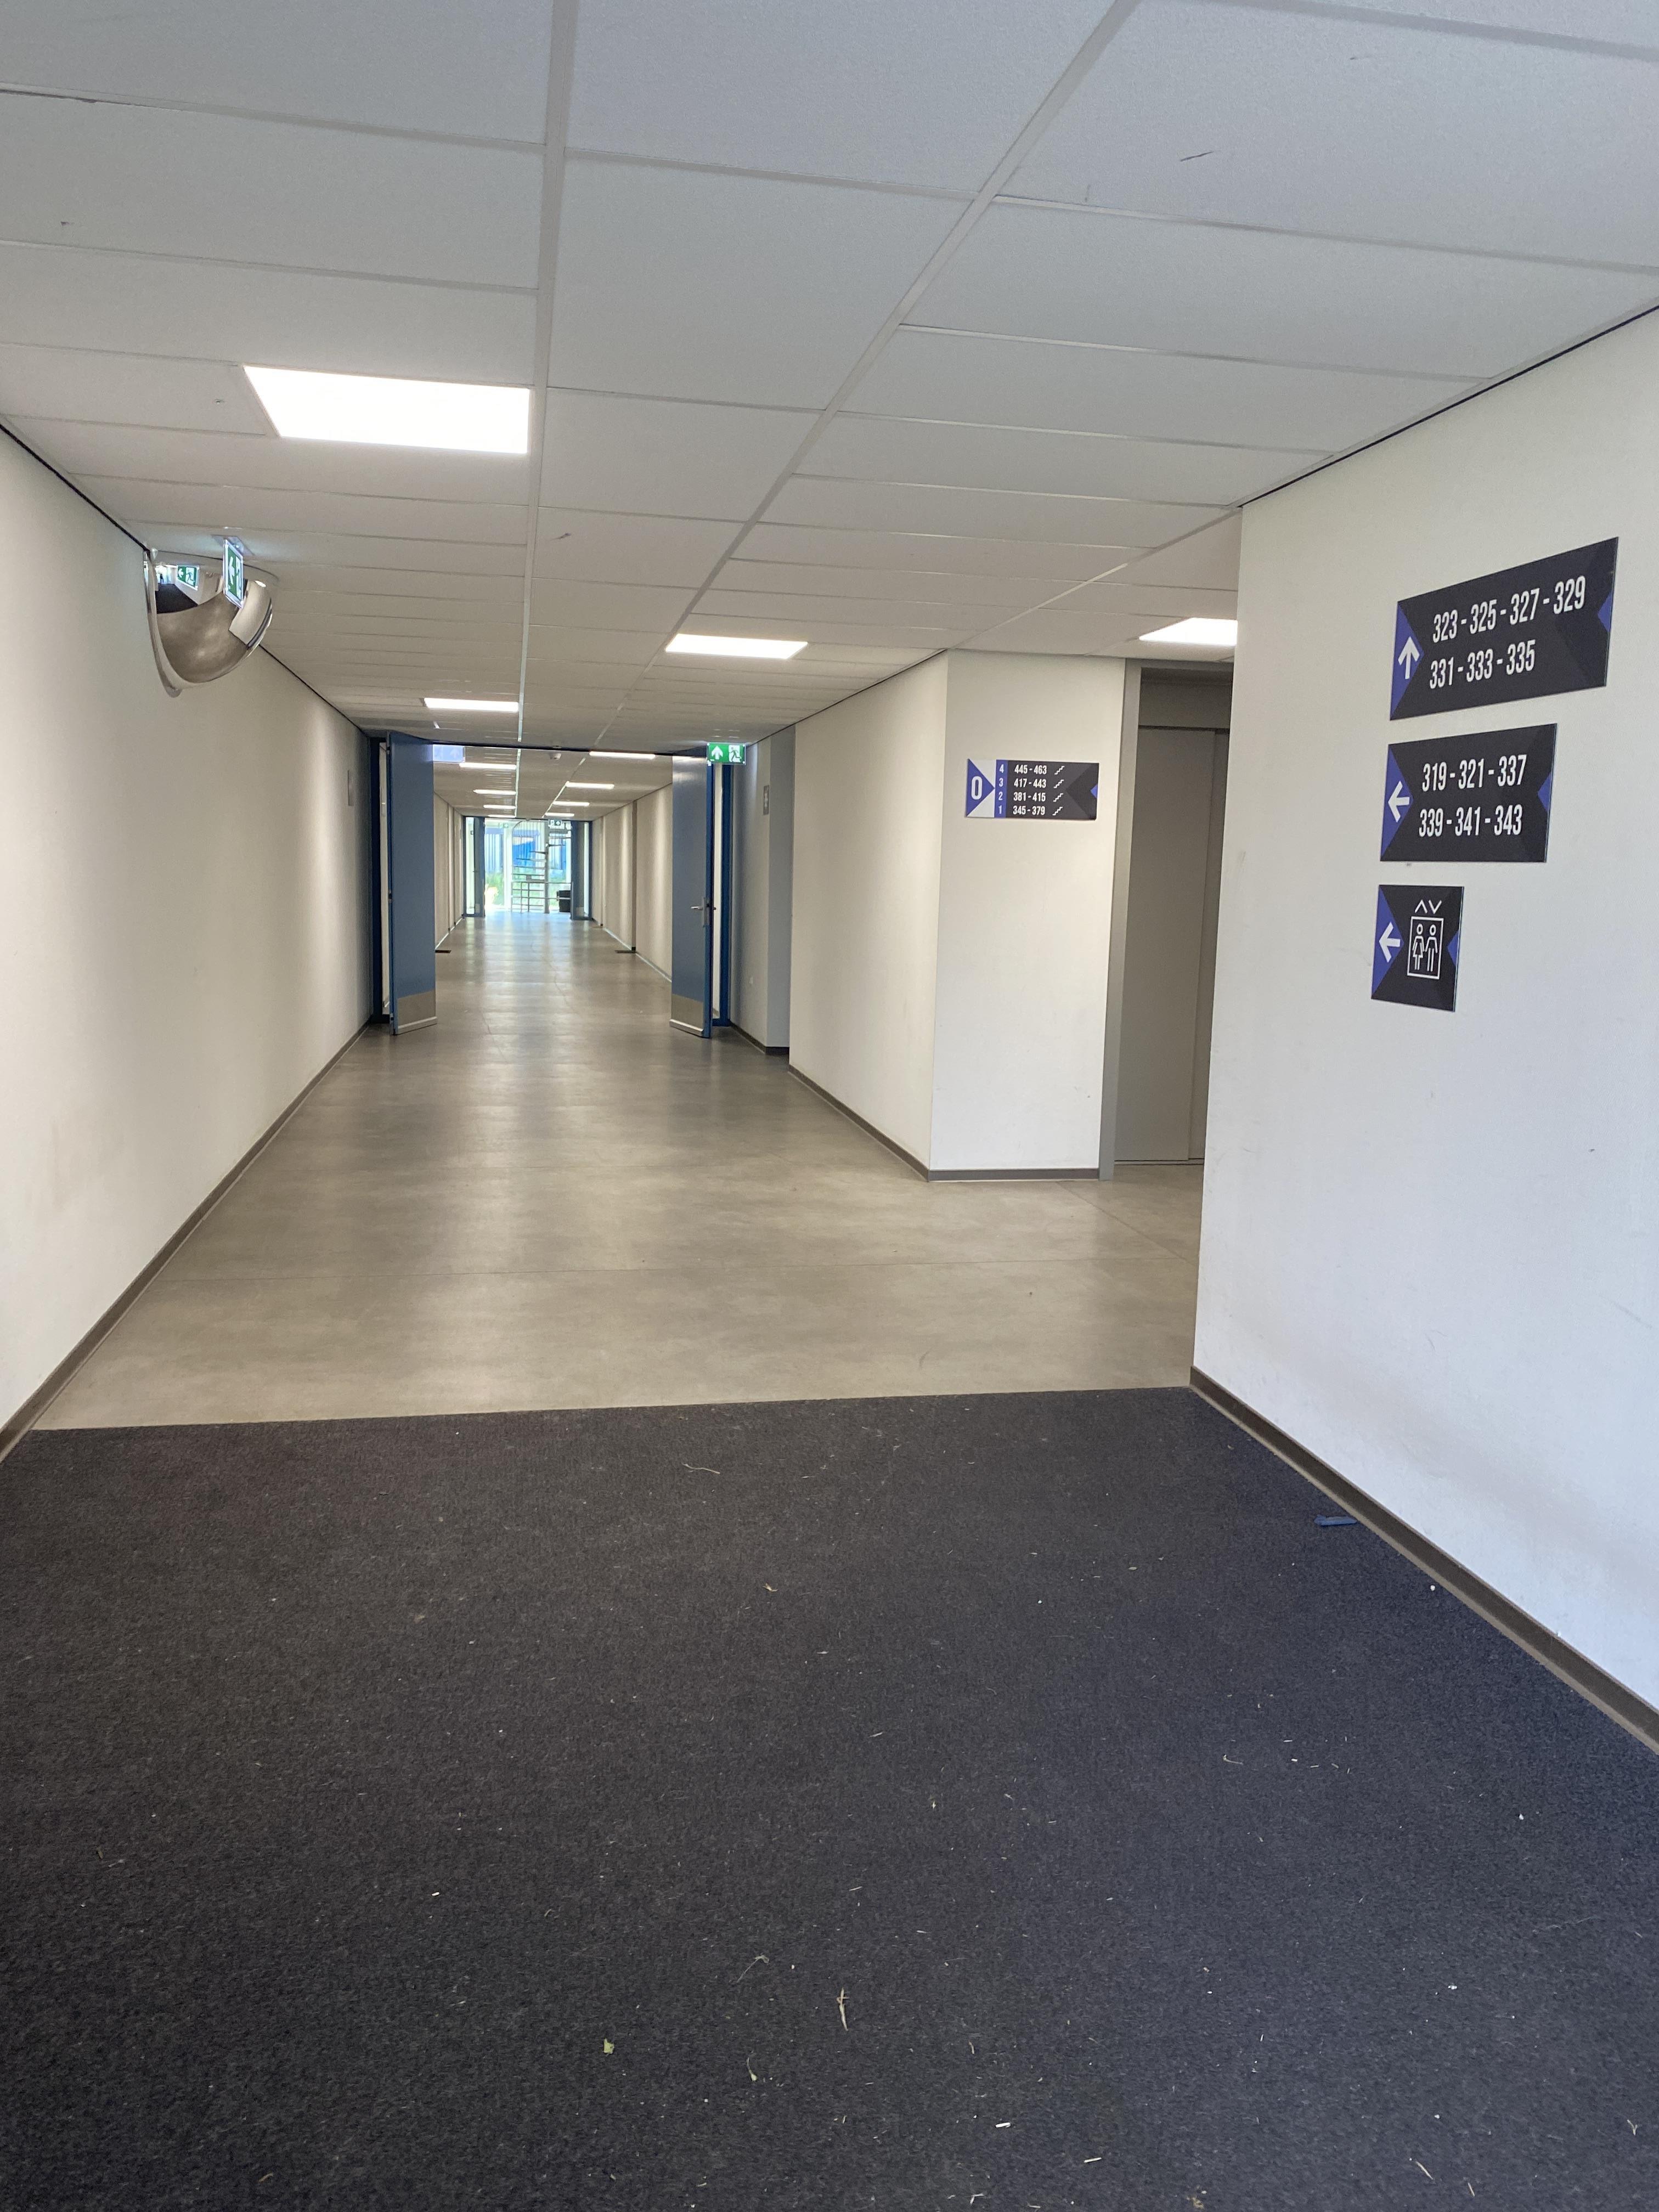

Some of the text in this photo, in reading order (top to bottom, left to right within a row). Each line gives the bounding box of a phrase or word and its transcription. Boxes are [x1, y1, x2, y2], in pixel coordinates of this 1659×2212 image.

[1432, 610, 1458, 643] 323
[1470, 599, 1497, 634] 325
[1510, 588, 1540, 625] 327
[1553, 575, 1585, 614] 329
[1429, 657, 1454, 689] 331
[1466, 648, 1493, 682] 333
[1506, 639, 1536, 675] 335
[999, 764, 1005, 773] 4
[1014, 764, 1028, 774] 445
[1033, 765, 1047, 775] 463
[1422, 761, 1447, 792] 319
[1458, 758, 1485, 789] 321
[1497, 754, 1527, 787] 337
[998, 777, 1003, 787] 3
[1013, 778, 1028, 788] 417
[1032, 778, 1047, 788] 443
[998, 791, 1003, 801] 2
[1013, 792, 1026, 802] 381
[1032, 792, 1046, 802] 415
[998, 805, 1002, 815] 1
[1013, 805, 1026, 815] 345
[1032, 805, 1046, 816] 379
[1419, 808, 1443, 837] 339
[1455, 806, 1481, 836] 341
[1494, 804, 1522, 836] 343
